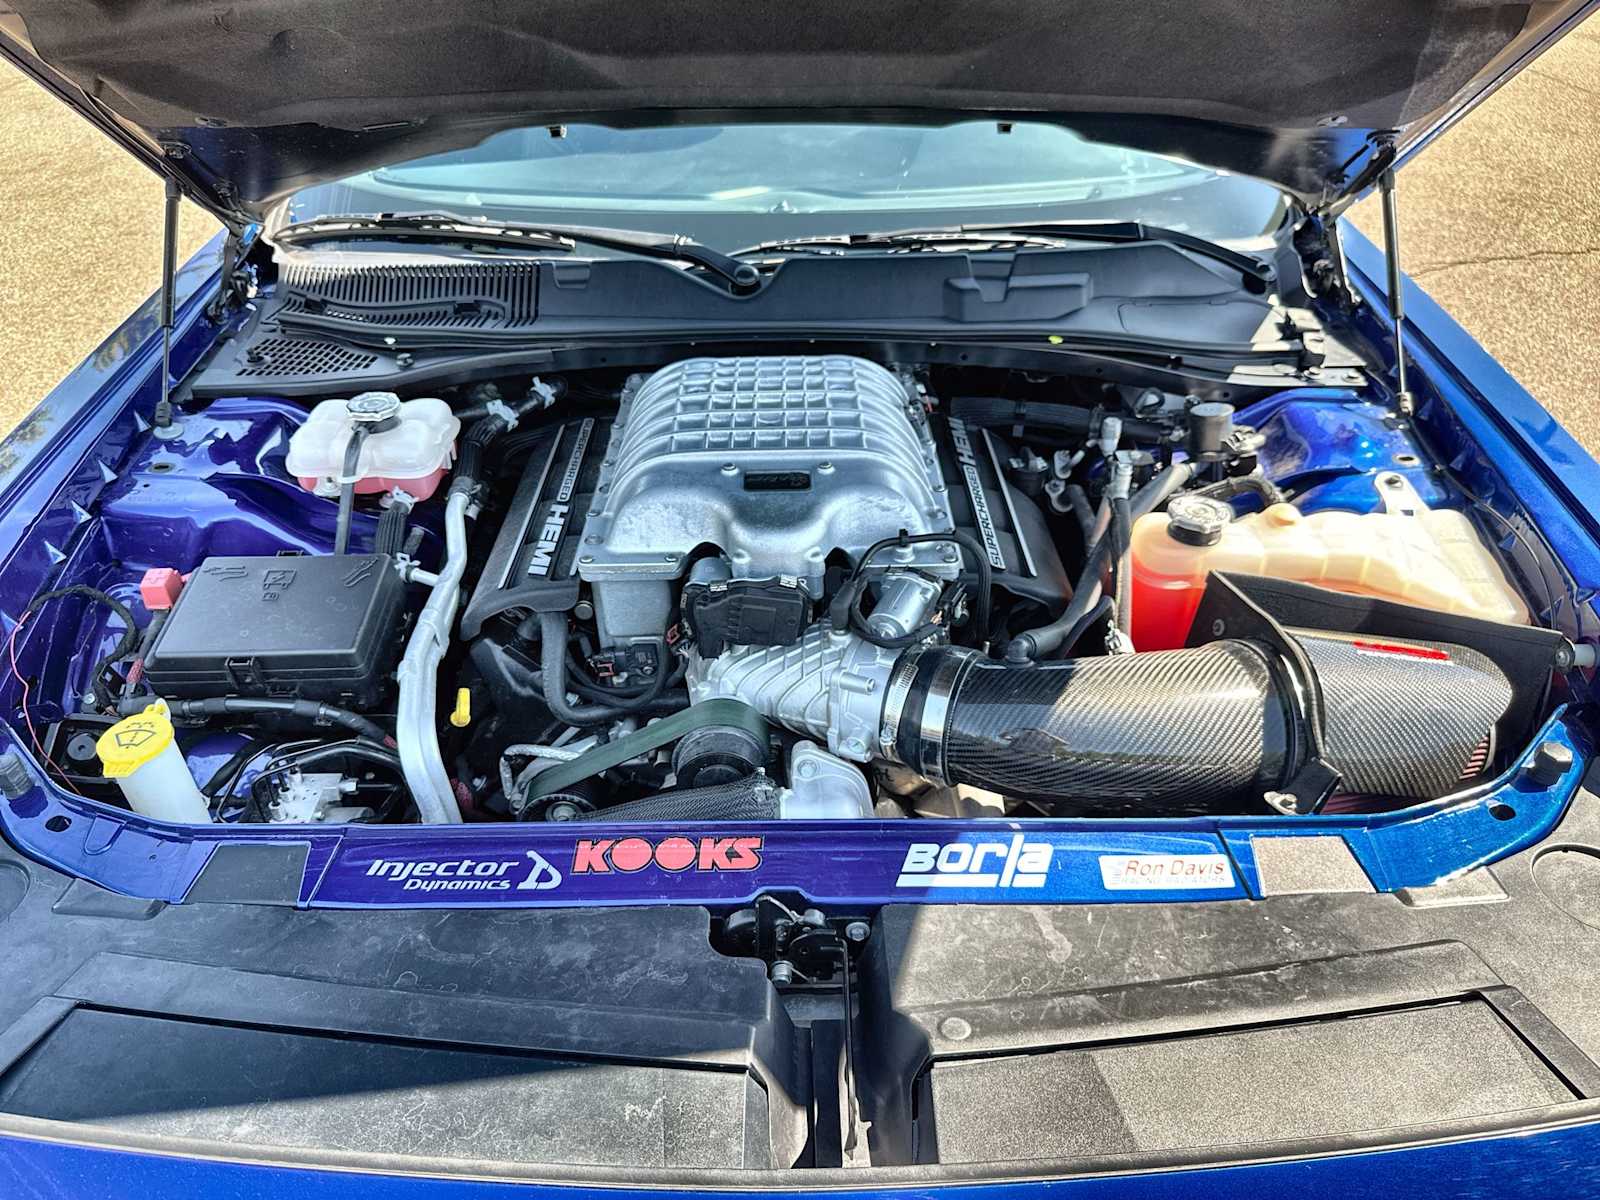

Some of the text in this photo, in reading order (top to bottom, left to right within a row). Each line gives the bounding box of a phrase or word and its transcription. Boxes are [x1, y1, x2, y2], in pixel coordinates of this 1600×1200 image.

[947, 416, 1003, 567] SUPERCHARGED HEMI
[528, 503, 570, 576] HEMI
[366, 859, 520, 881] Injector
[571, 836, 763, 874] KOOKS
[1125, 859, 1225, 876] Ron Davis
[403, 878, 511, 892] Dynamics
